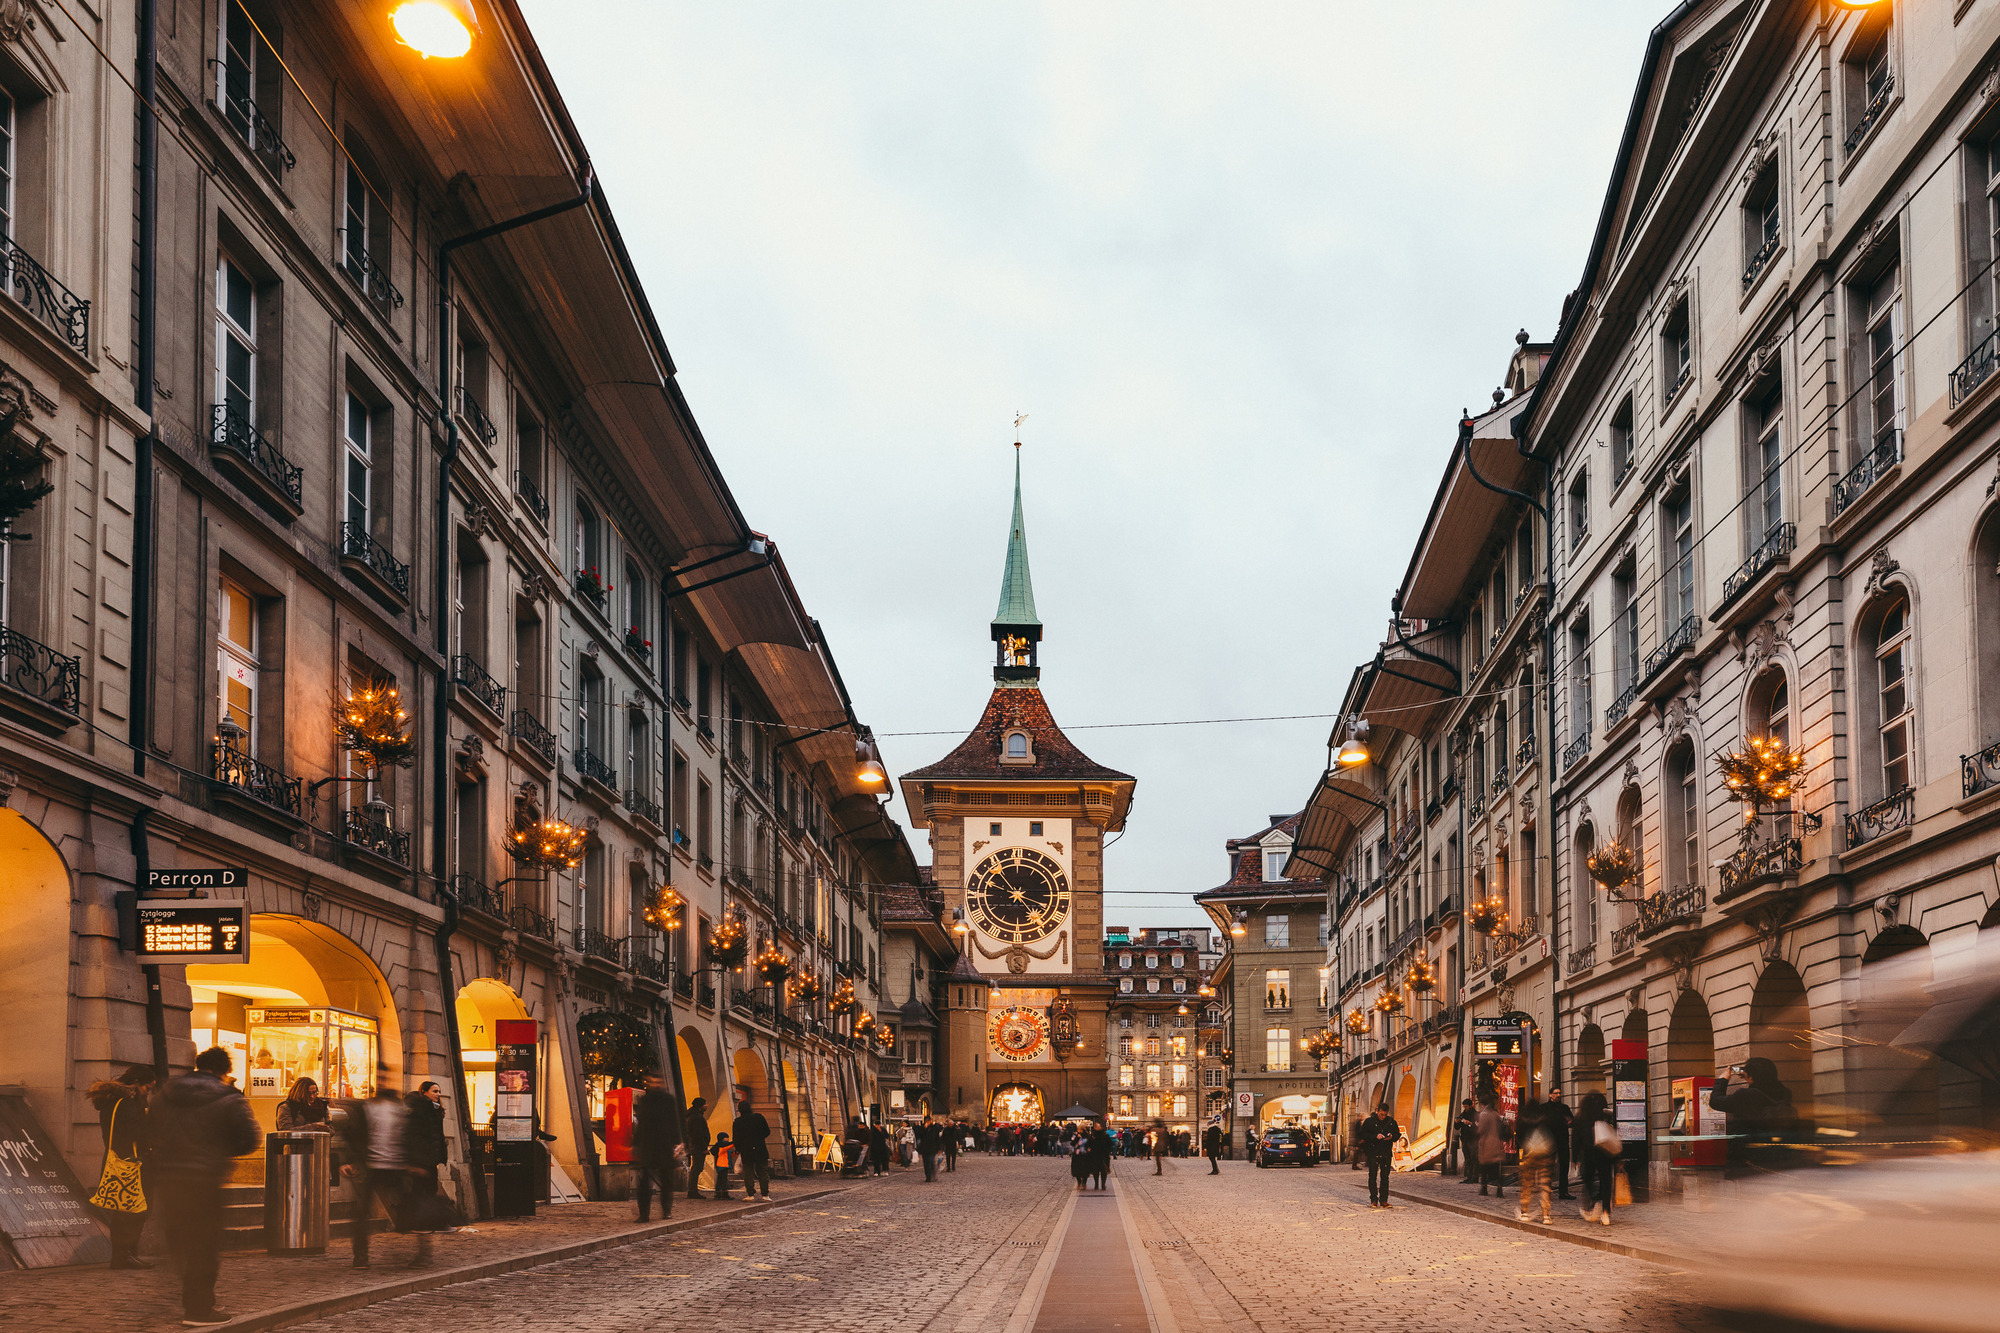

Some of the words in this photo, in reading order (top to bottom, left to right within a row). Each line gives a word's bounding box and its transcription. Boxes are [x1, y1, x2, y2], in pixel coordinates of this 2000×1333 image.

[149, 871, 214, 885] Perron
[222, 871, 235, 885] D
[141, 910, 176, 918] Zytglogge
[145, 925, 155, 934] 12
[156, 925, 182, 934] Zentrum
[182, 925, 196, 933] Paul
[145, 933, 155, 942] 12
[156, 933, 182, 942] Zentrum
[182, 933, 196, 942] Paul
[145, 942, 155, 951] 12
[156, 942, 182, 951] Zentrum
[182, 942, 196, 950] Paul
[1477, 1018, 1508, 1026] Perron
[472, 1025, 484, 1034] 71
[252, 1077, 275, 1087] äuä
